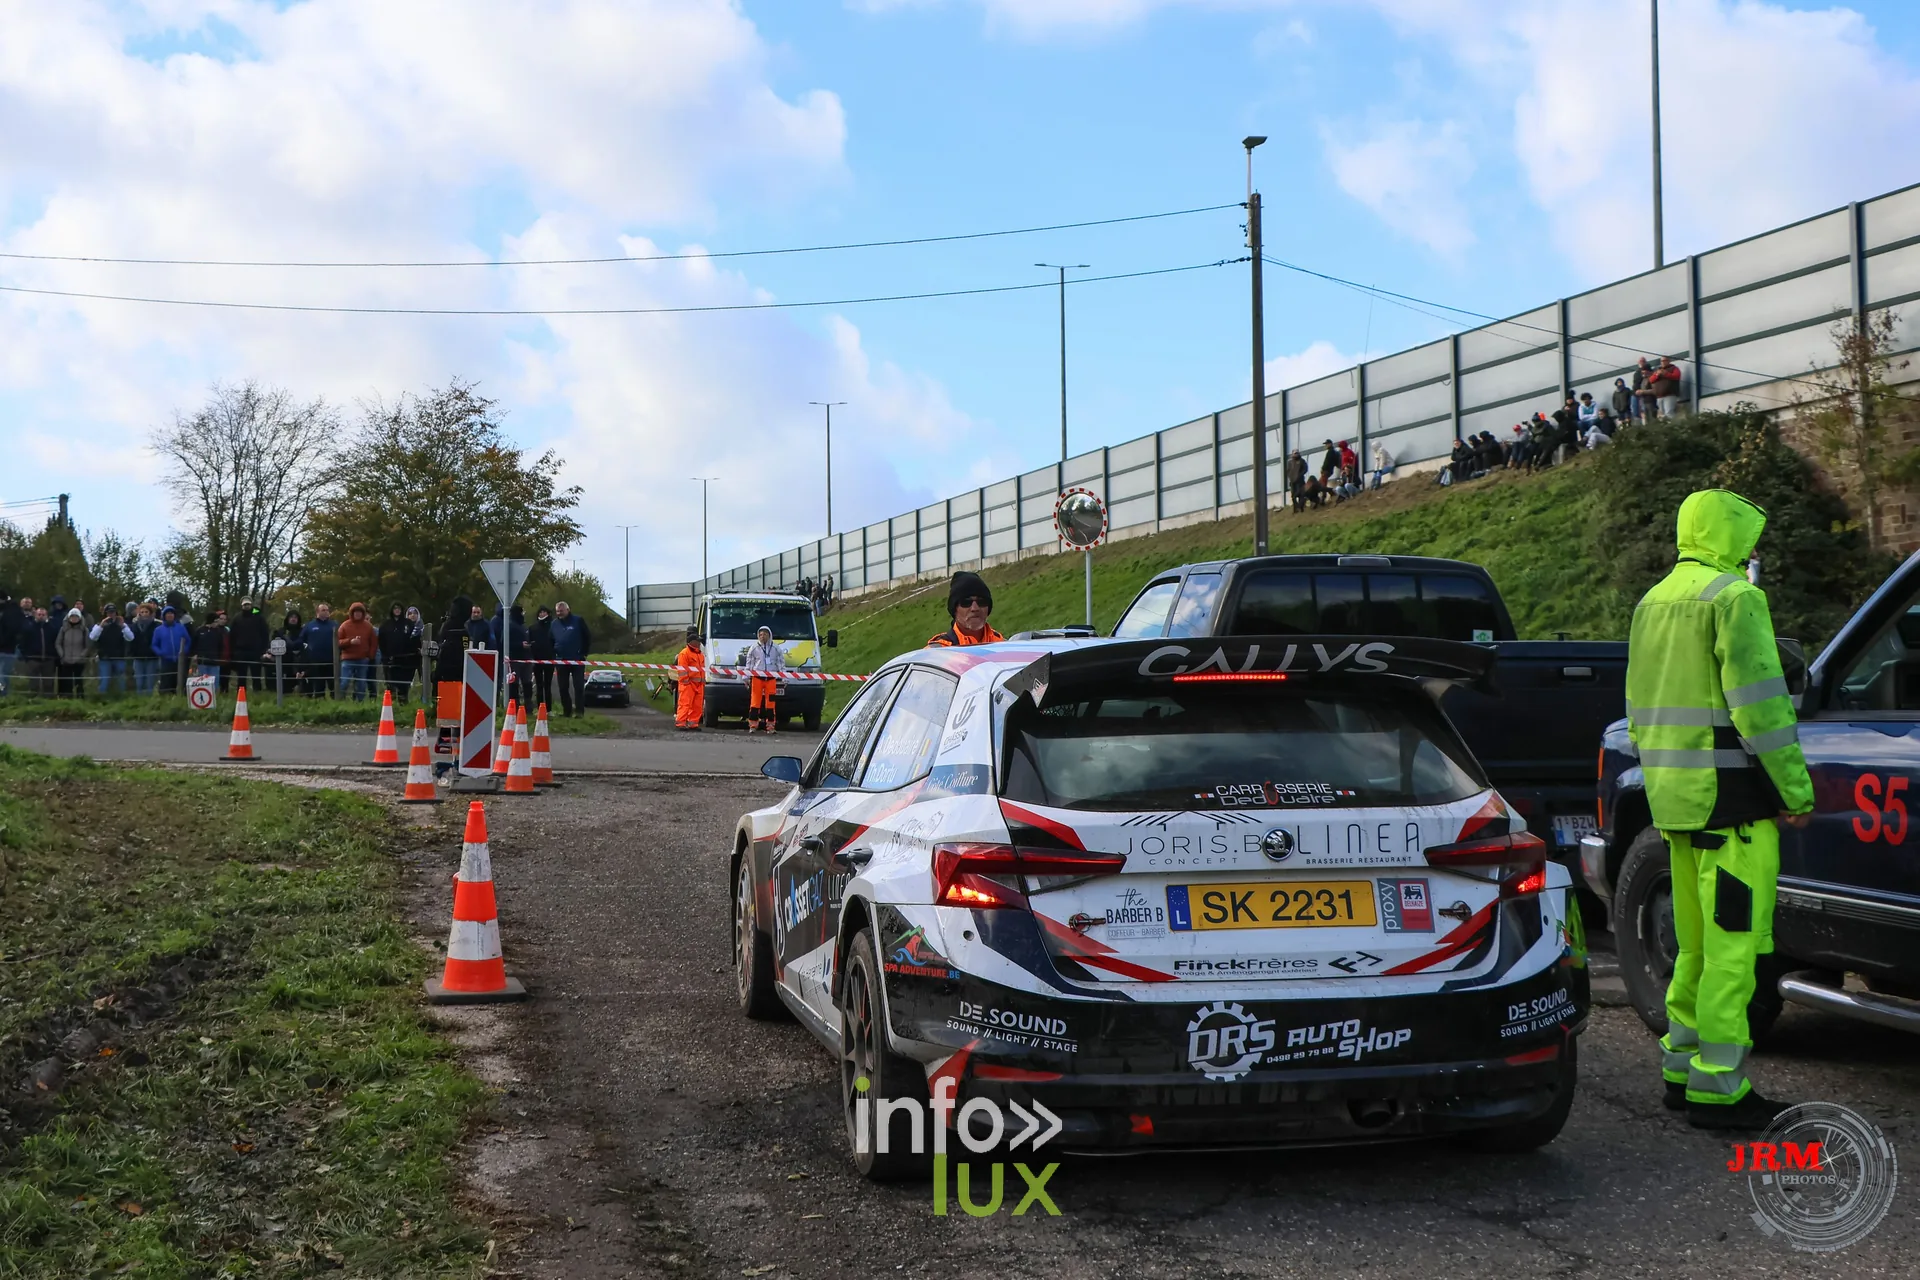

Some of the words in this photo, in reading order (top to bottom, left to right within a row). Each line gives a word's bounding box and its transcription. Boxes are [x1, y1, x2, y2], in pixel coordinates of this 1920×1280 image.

[1215, 781, 1333, 800] CARROSSERIE
[1852, 772, 1909, 846] S5
[1118, 834, 1262, 856] JORIS.B
[1297, 822, 1420, 854] LINEA
[1149, 857, 1238, 866] CONCEPT
[1306, 856, 1354, 865] BRASSERIE
[1358, 856, 1413, 864] RESTAURANT
[1106, 907, 1152, 924] BARBER
[1156, 907, 1164, 922] B
[1116, 888, 1148, 912] the
[1202, 889, 1260, 924] SK
[1269, 889, 1354, 922] 2231
[1380, 881, 1401, 930] proxy
[1176, 909, 1187, 925] L
[884, 963, 898, 973] SPA
[959, 1001, 1067, 1035] DE.SOUND
[1508, 987, 1567, 1021] DE.SOUND
[946, 1019, 979, 1035] SOUND
[995, 1033, 1027, 1045] LIGHT
[1043, 1040, 1078, 1053] STAGE
[1500, 1024, 1528, 1037] SOUND
[1538, 1014, 1557, 1028] LIGHT
[1561, 1004, 1577, 1018] STAGE
[1187, 1019, 1276, 1062] DRS
[1287, 1019, 1361, 1047] AUTO
[1337, 1028, 1412, 1061] SHOP
